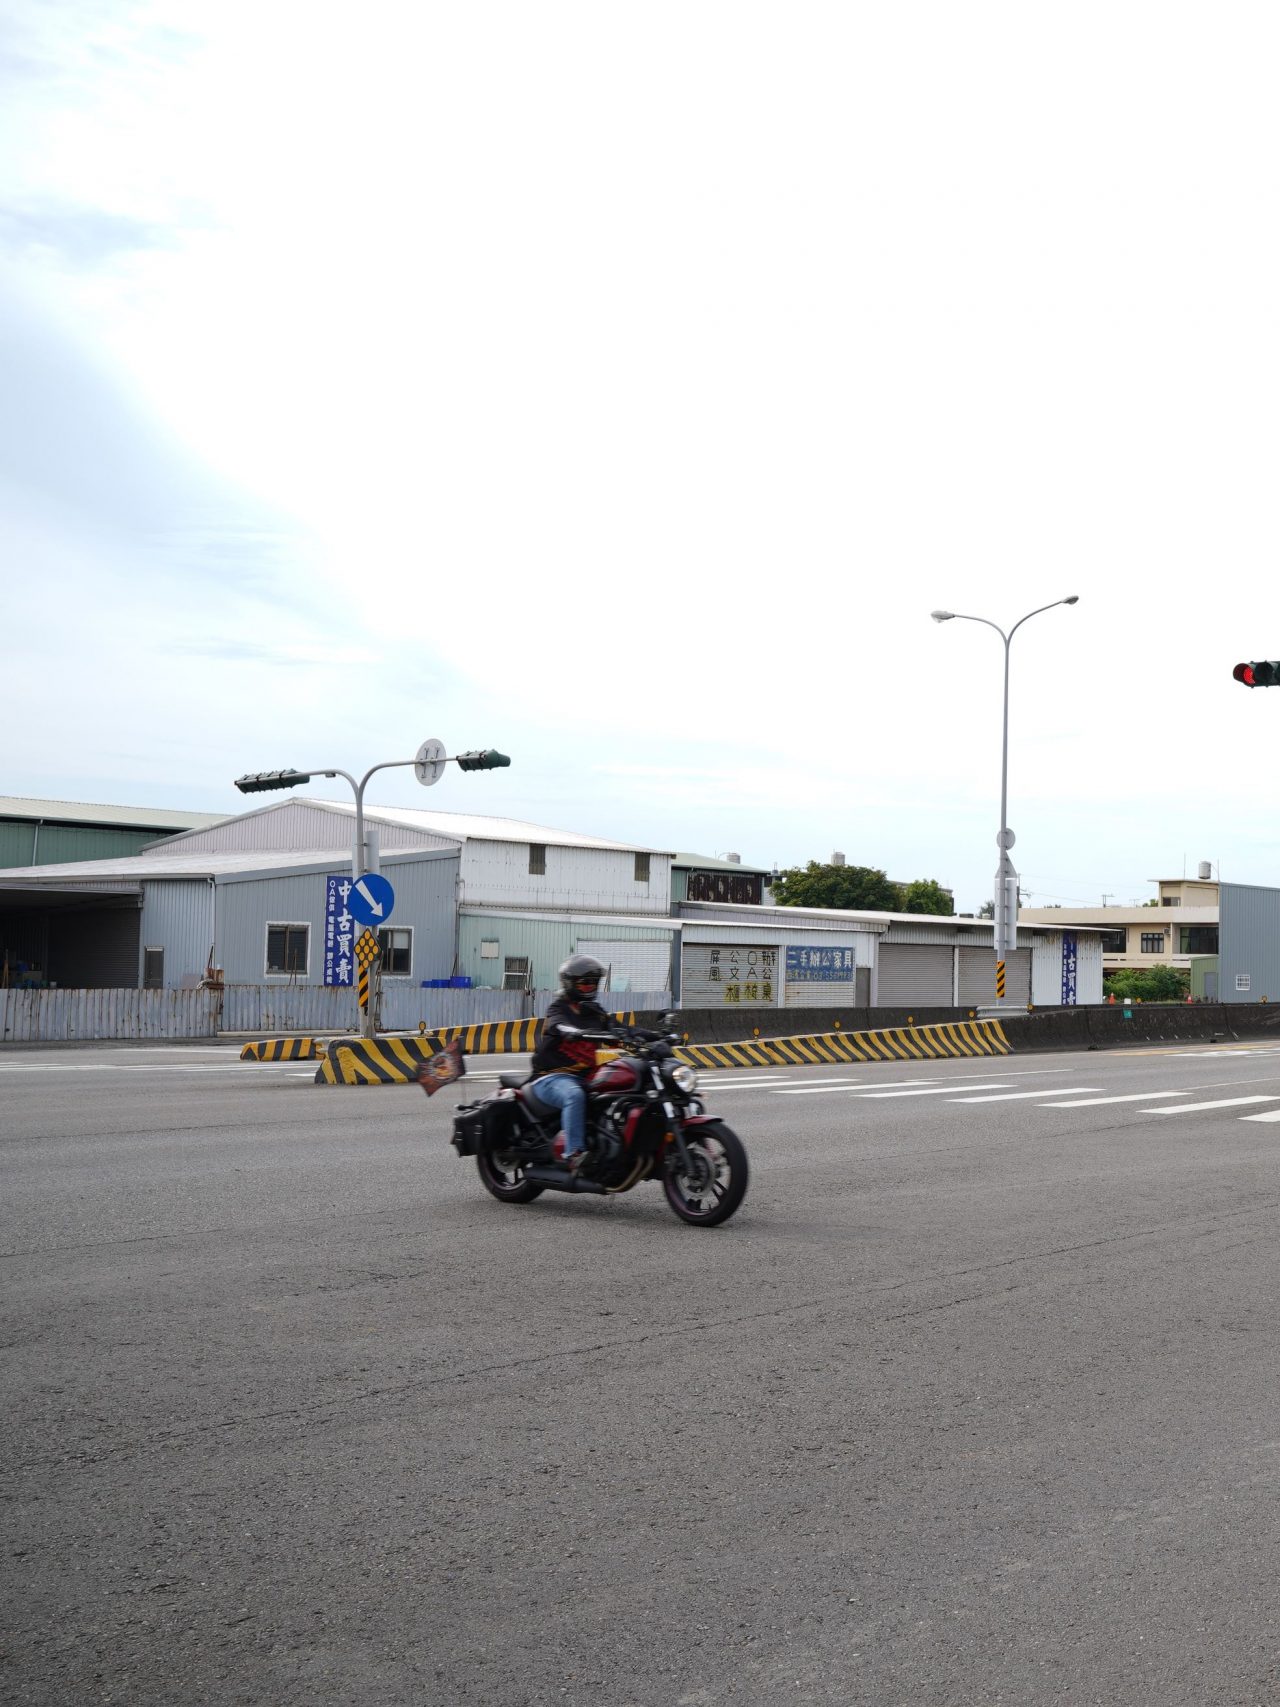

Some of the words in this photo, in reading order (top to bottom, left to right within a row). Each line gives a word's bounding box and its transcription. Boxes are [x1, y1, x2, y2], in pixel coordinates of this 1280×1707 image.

[336, 880, 353, 984] 中古買賣
[708, 950, 721, 982] 屏風
[787, 950, 852, 969] 二手辦公家具
